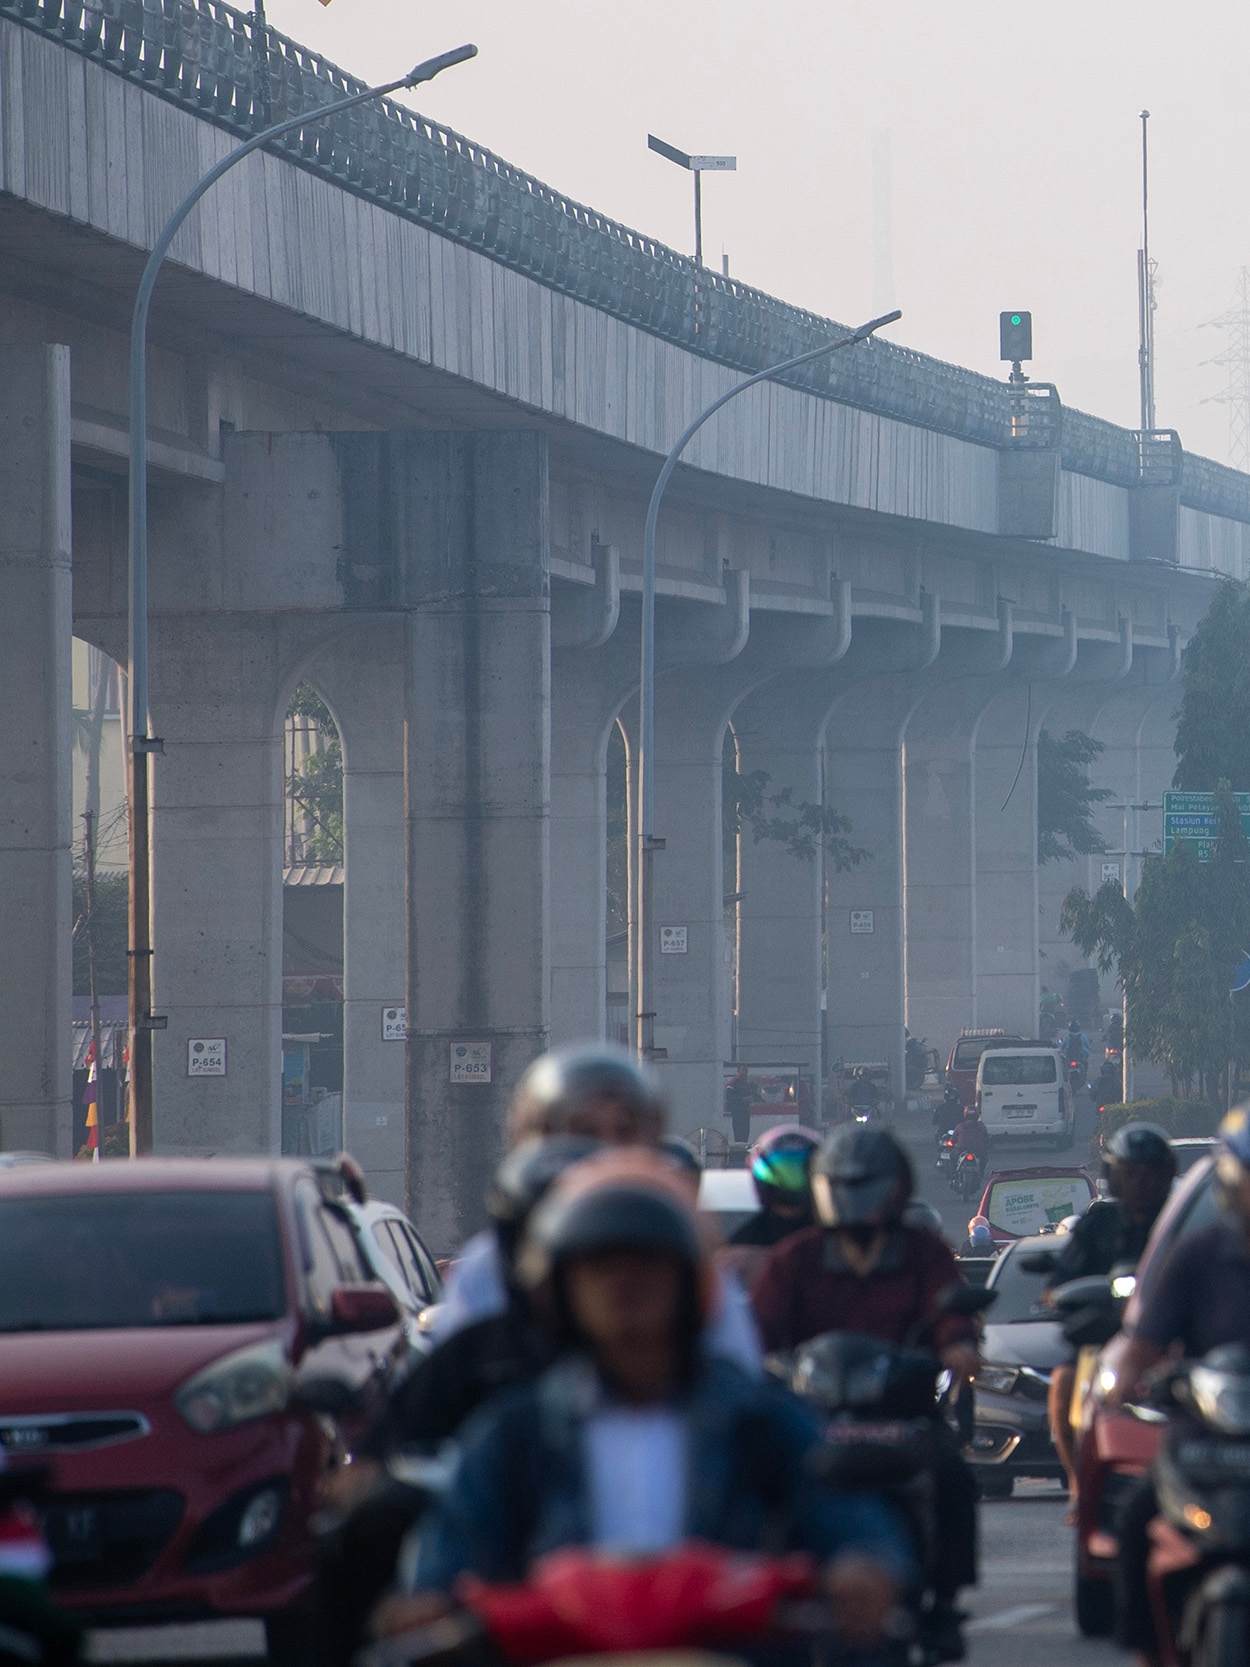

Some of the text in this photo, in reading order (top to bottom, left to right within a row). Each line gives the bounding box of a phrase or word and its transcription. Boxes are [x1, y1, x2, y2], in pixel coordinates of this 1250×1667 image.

[1171, 803, 1185, 811] Mal
[1170, 816, 1201, 825] Stasiun
[1170, 826, 1210, 836] Lampung
[1198, 840, 1213, 849] Pla
[386, 1024, 406, 1032] P-65
[192, 1057, 222, 1067] P-654
[454, 1063, 487, 1073] P-653
